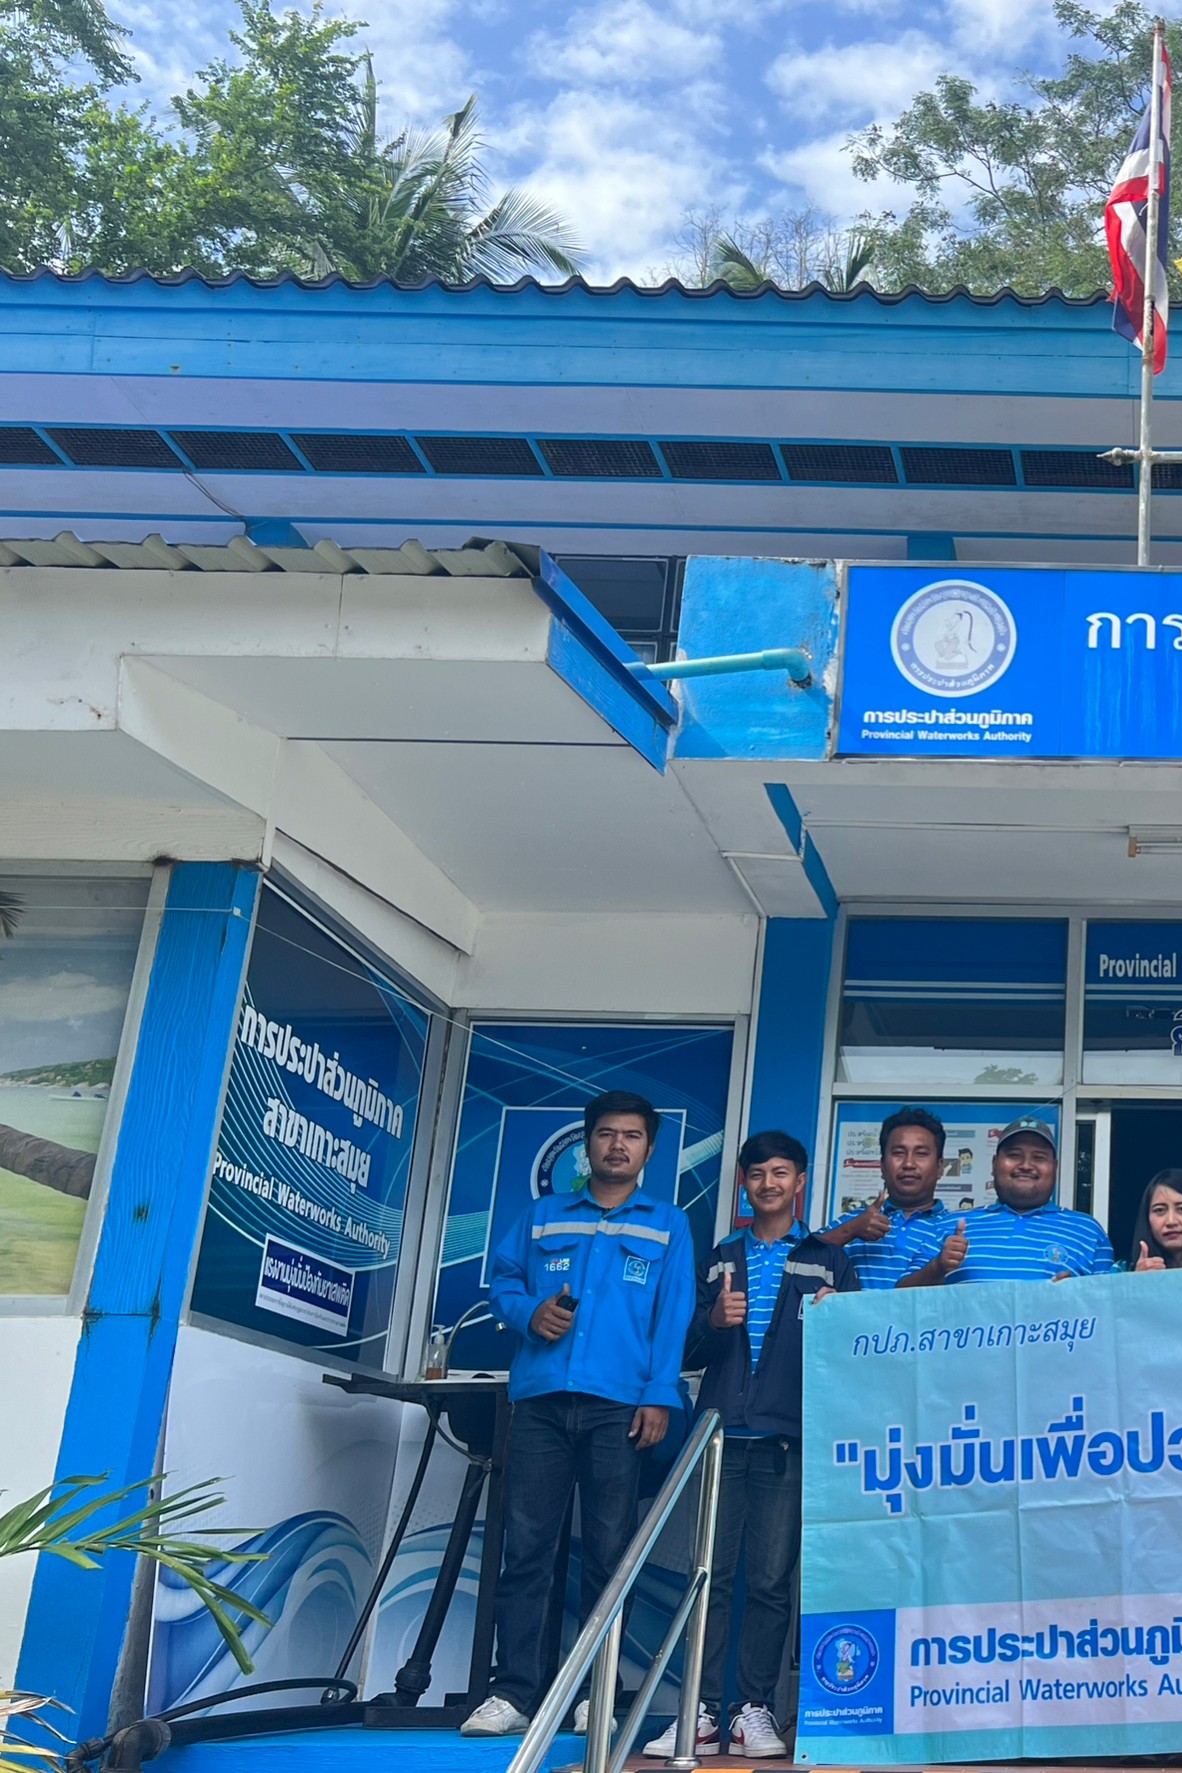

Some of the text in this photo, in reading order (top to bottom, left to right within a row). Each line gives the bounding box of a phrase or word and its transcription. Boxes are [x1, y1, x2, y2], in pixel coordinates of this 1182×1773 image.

[863, 707, 1033, 729] การประปาส่วนภูมิภาค
[861, 729, 1032, 743] Provincial Waterworks Authority
[1100, 953, 1177, 978] Provincial
[241, 1003, 404, 1140] การประปาส่วนภูมิภาค
[262, 1096, 372, 1195] สาขาเกาะสมุย
[212, 1151, 392, 1260] Provincial Waterworks Authority
[543, 1263, 570, 1272] 1662
[852, 1314, 1097, 1357] กปภ.สาขาเกาะสมุย
[910, 1680, 1010, 1707] Provincial
[1019, 1673, 1148, 1701] Waterworks
